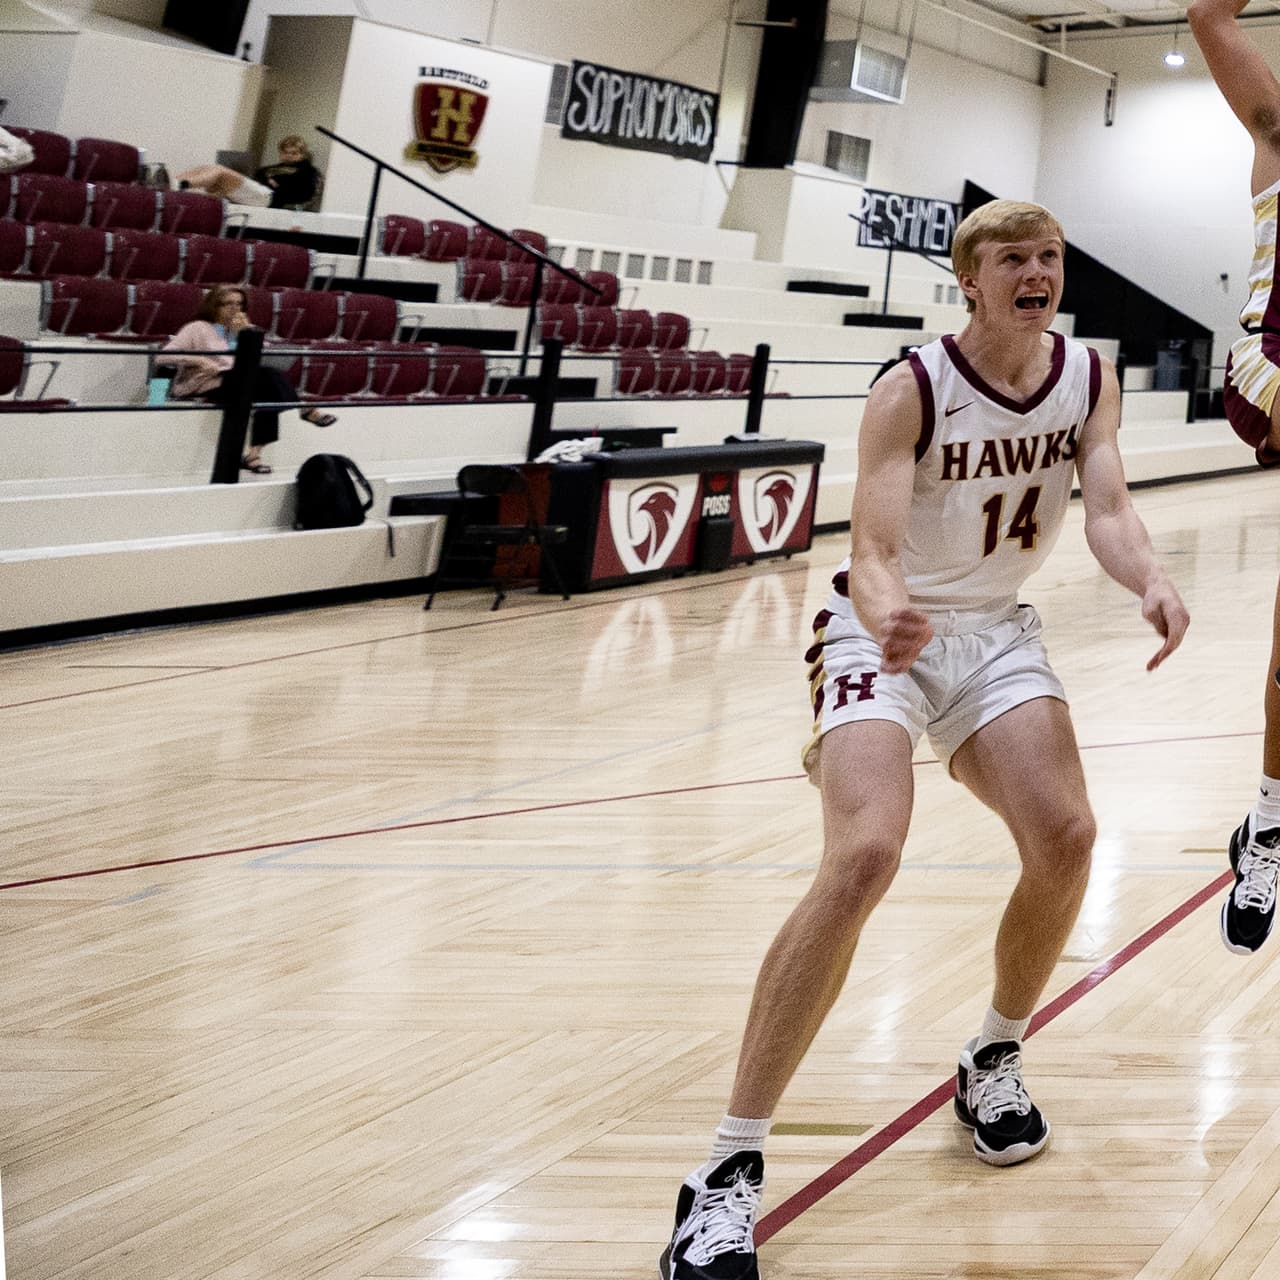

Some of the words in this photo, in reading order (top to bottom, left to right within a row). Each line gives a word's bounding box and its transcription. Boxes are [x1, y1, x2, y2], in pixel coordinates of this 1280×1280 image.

[567, 65, 713, 146] SOPHOMORES
[940, 423, 1078, 481] HAWKS
[702, 494, 731, 516] POSS
[981, 484, 1040, 558] 14
[833, 671, 878, 711] H
